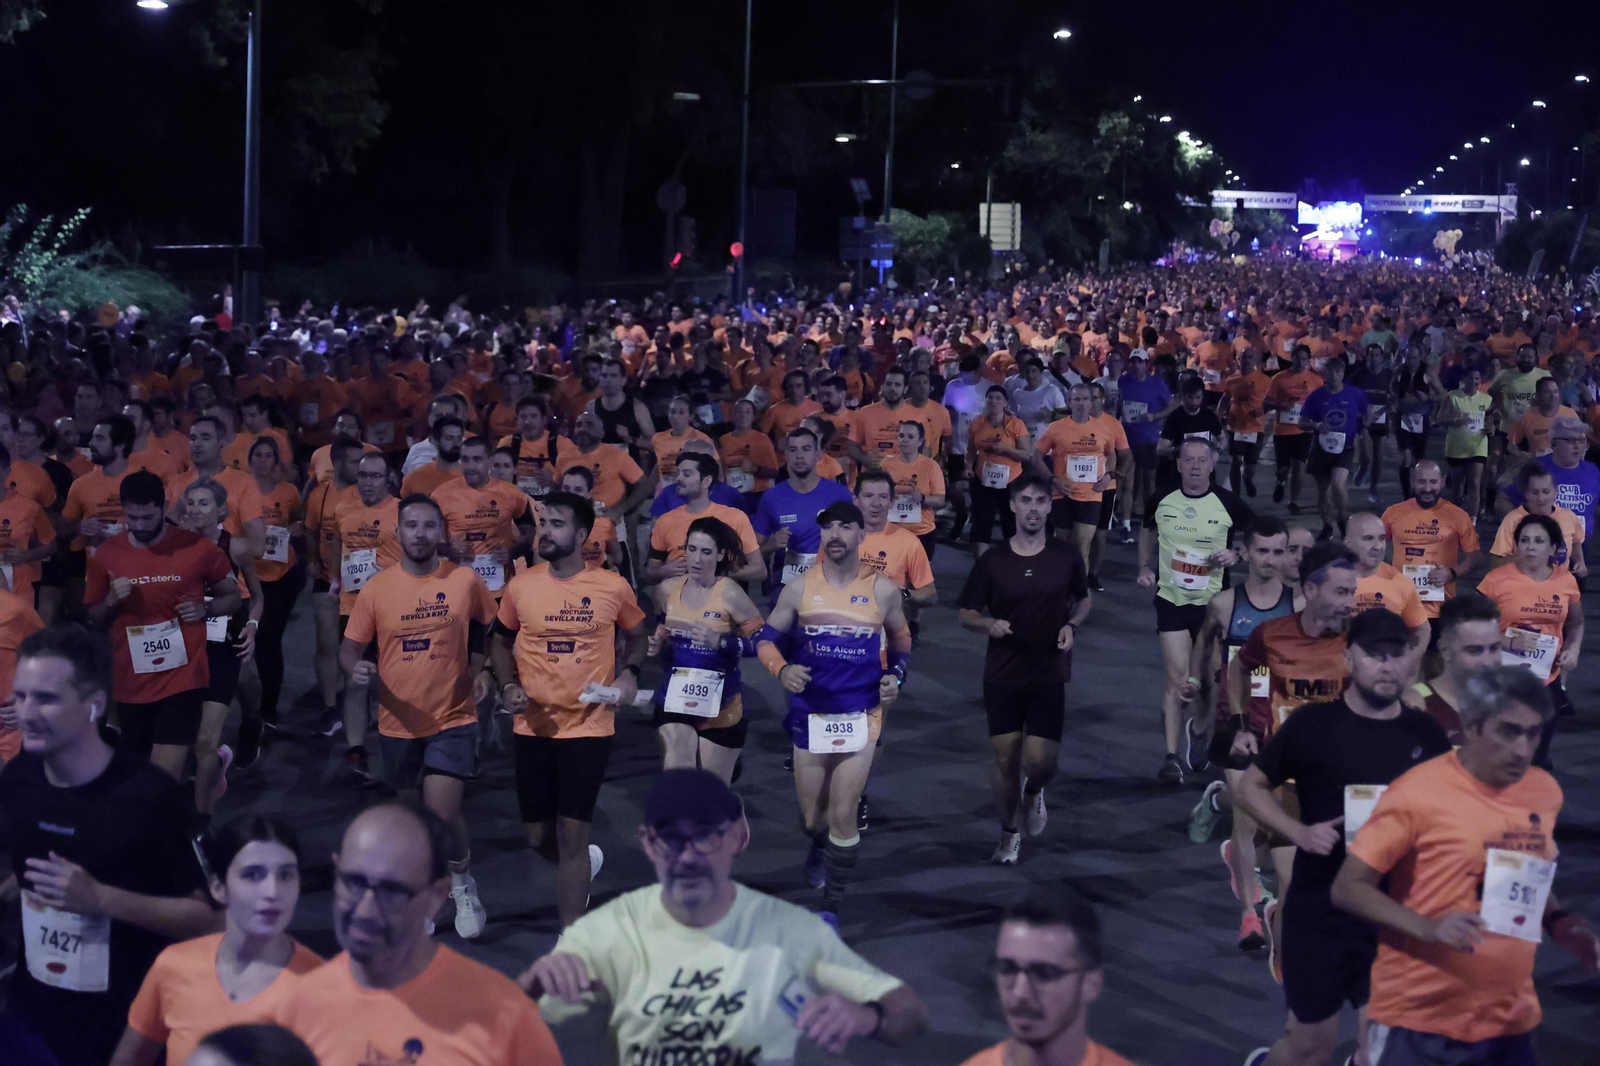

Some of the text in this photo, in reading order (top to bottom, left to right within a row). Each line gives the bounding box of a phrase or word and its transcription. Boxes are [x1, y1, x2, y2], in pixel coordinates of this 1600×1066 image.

[1073, 464, 1093, 472] 11693
[1559, 485, 1580, 495] CLUB
[896, 503, 913, 511] 6316
[1174, 525, 1198, 533] CARLOS
[1182, 563, 1203, 575] 1374
[151, 574, 181, 583] steria
[415, 604, 450, 613] NOCTURNA
[1520, 606, 1547, 614] SEVILLA
[400, 612, 431, 621] SEVILLA
[143, 638, 171, 653] 2540
[816, 642, 866, 655] Los Alcores
[682, 683, 709, 697] 4939
[825, 722, 854, 734] 4938
[40, 926, 83, 954] 7427
[670, 967, 723, 991] LAS
[642, 990, 747, 1016] CHICAS
[658, 1020, 726, 1043] SON
